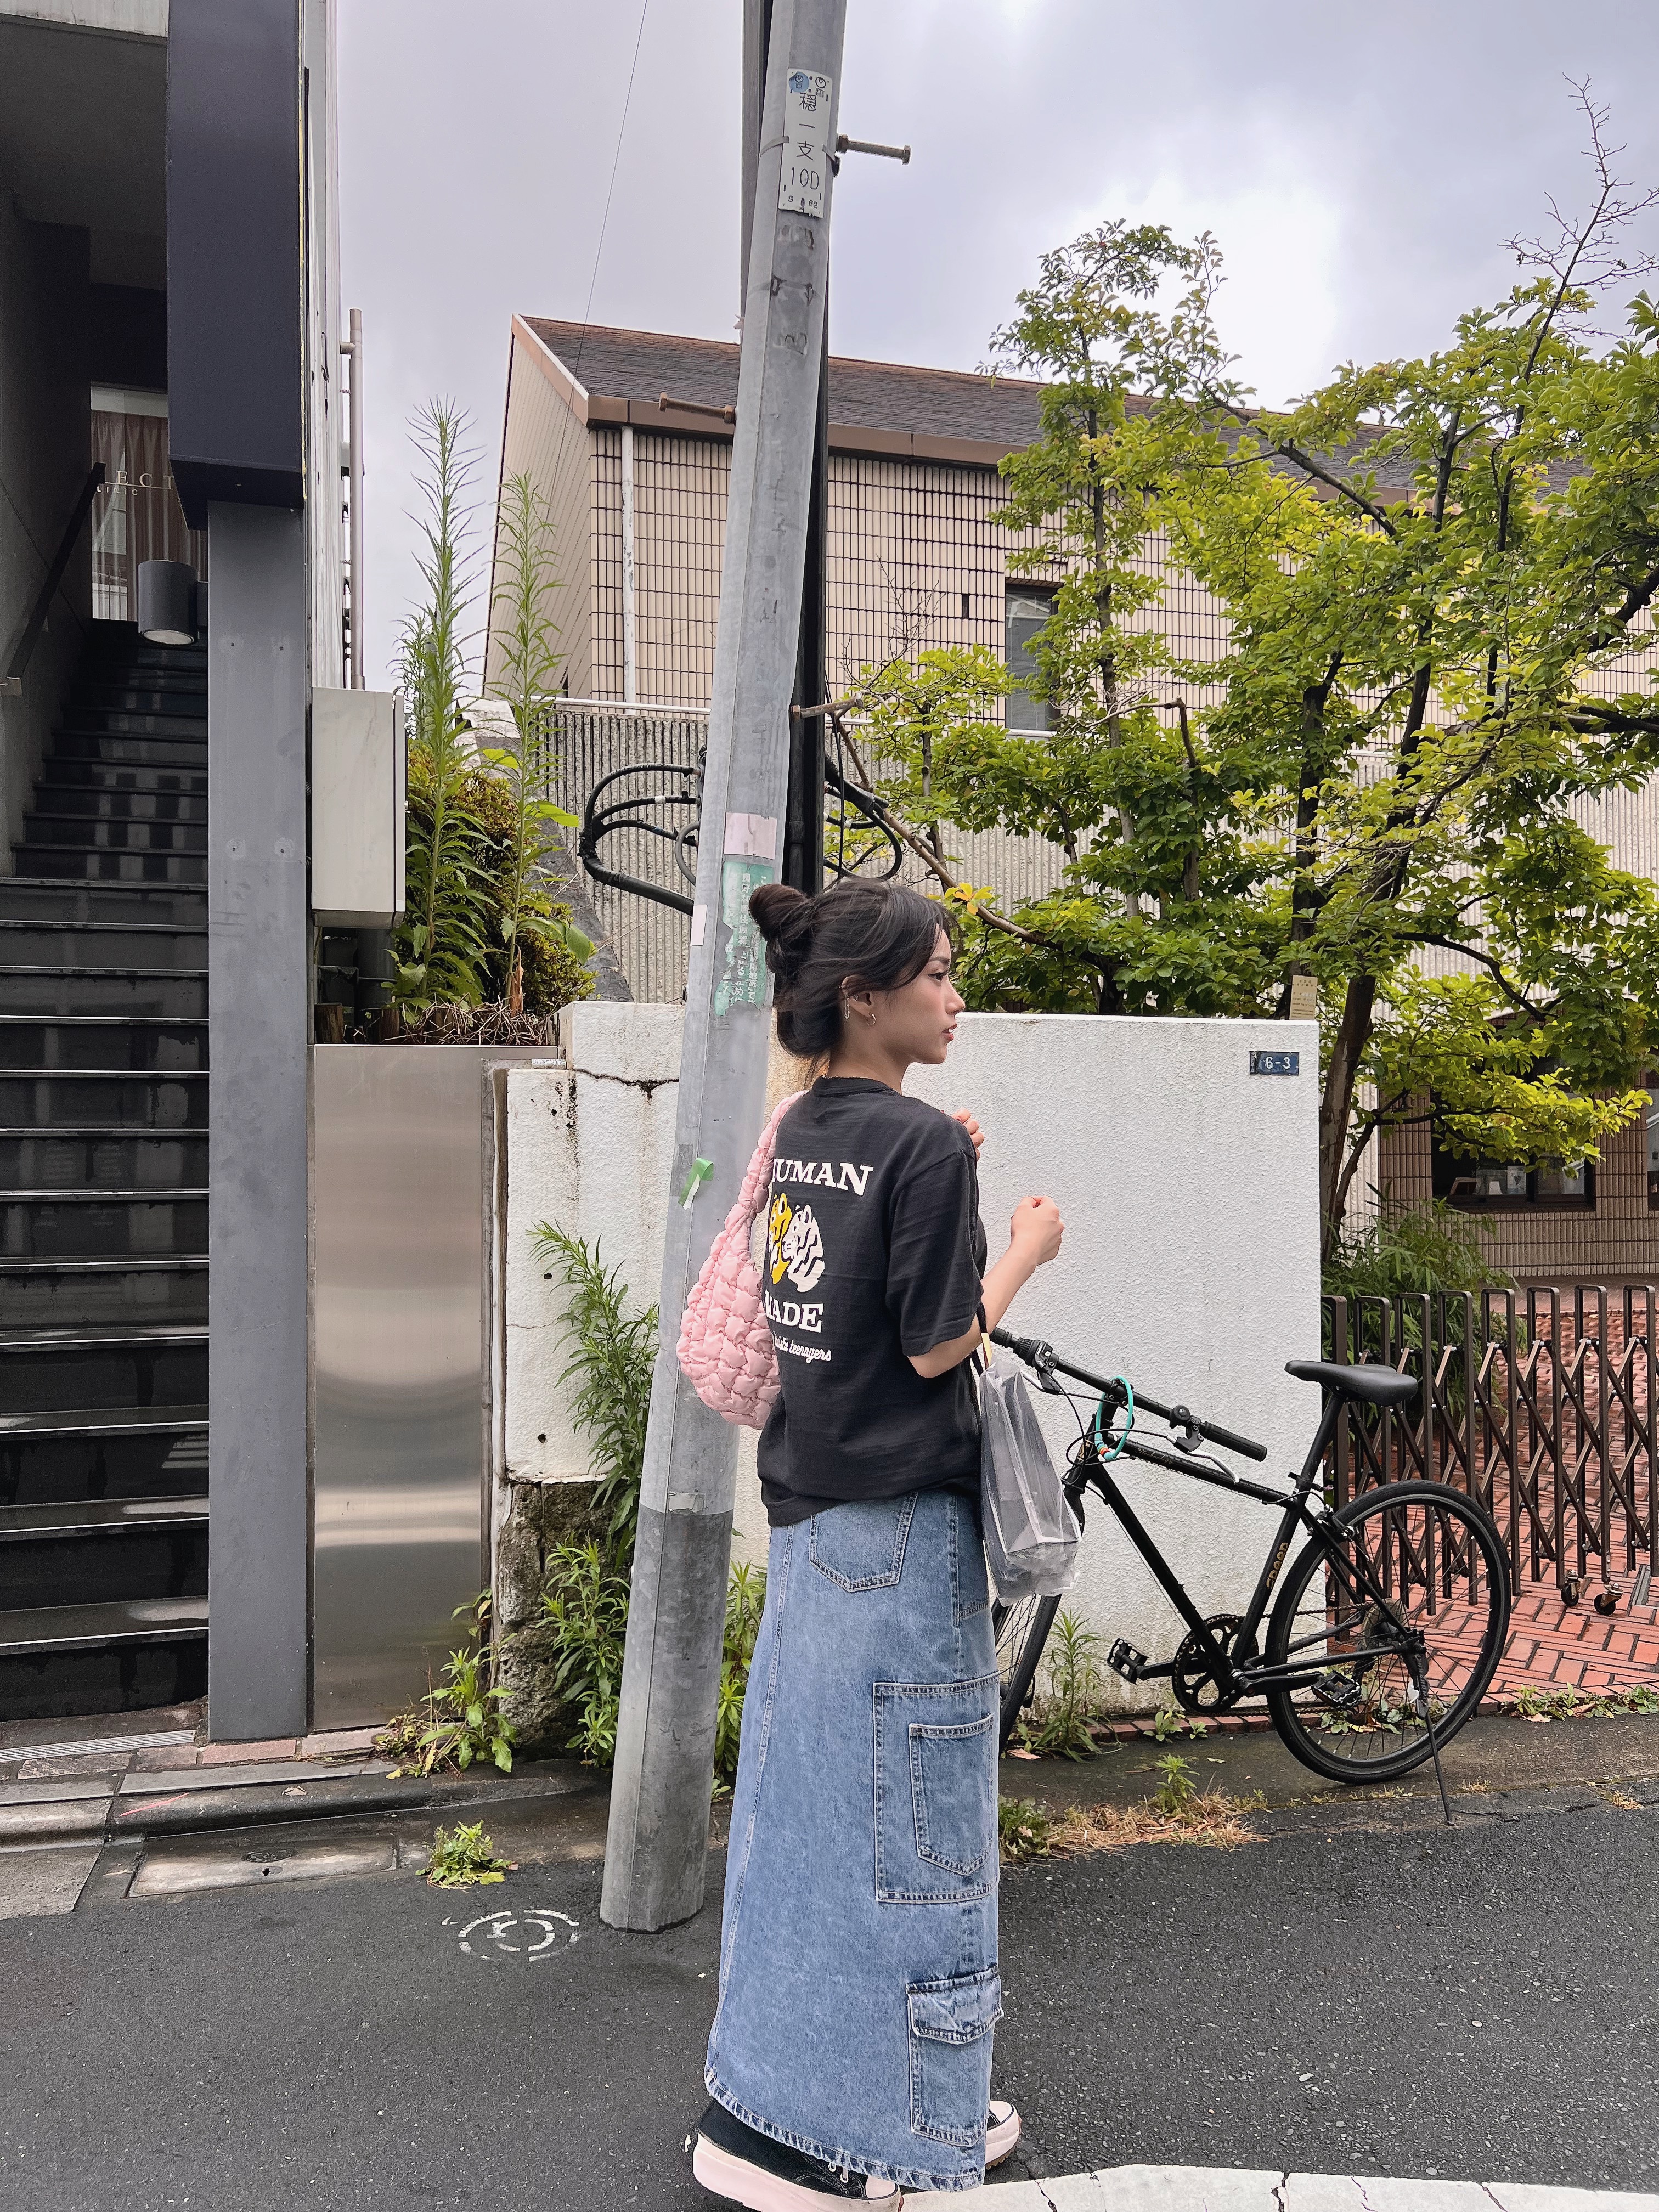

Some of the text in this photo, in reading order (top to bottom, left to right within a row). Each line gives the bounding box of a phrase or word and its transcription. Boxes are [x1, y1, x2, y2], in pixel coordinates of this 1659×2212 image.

[97, 486, 138, 496] LINIC
[1266, 1056, 1291, 1069] 6-3
[772, 1158, 874, 1197] UMAN
[789, 1339, 832, 1364] teenagers
